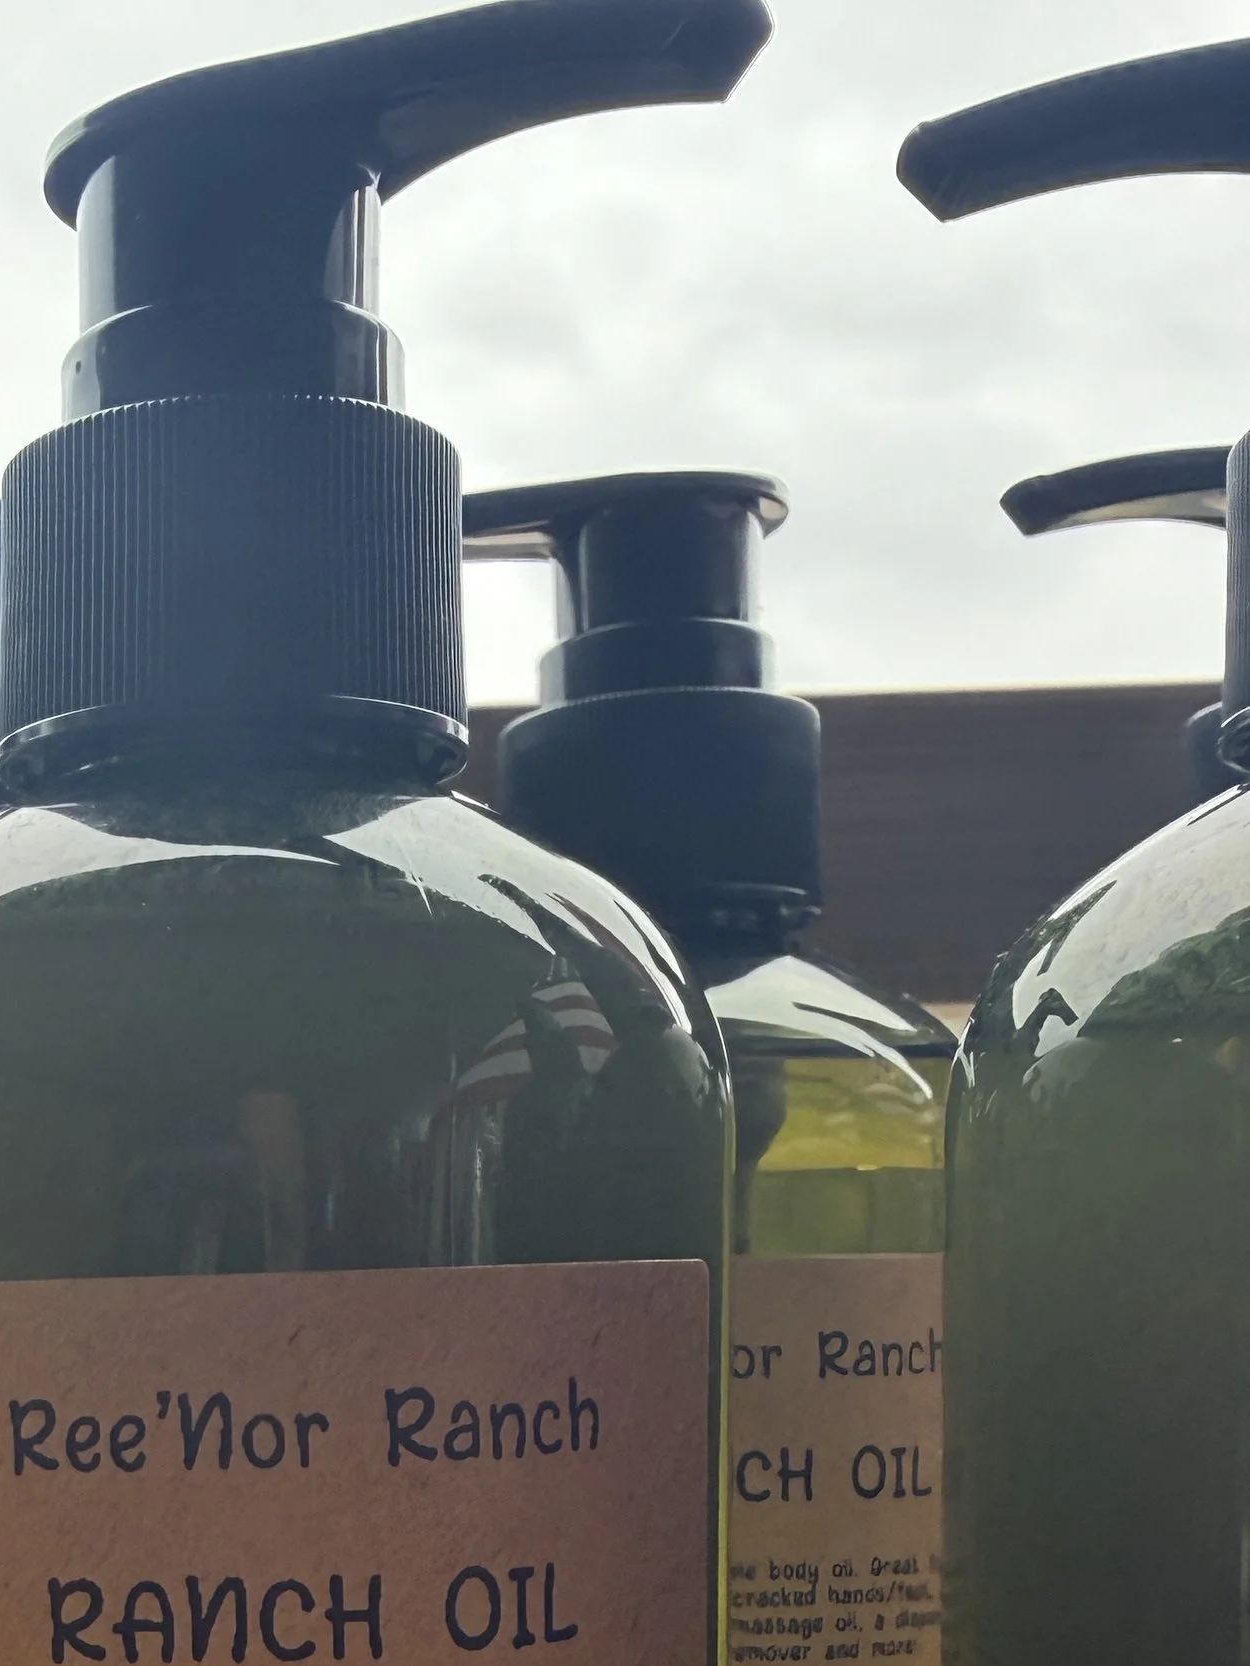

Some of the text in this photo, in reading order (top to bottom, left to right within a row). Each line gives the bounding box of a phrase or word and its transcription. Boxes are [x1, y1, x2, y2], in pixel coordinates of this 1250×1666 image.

[9, 1377, 600, 1476] Ree'Nor Ranch
[851, 1444, 932, 1499] OIL
[767, 1558, 819, 1585] body
[46, 1562, 579, 1665] RANCH OIL
